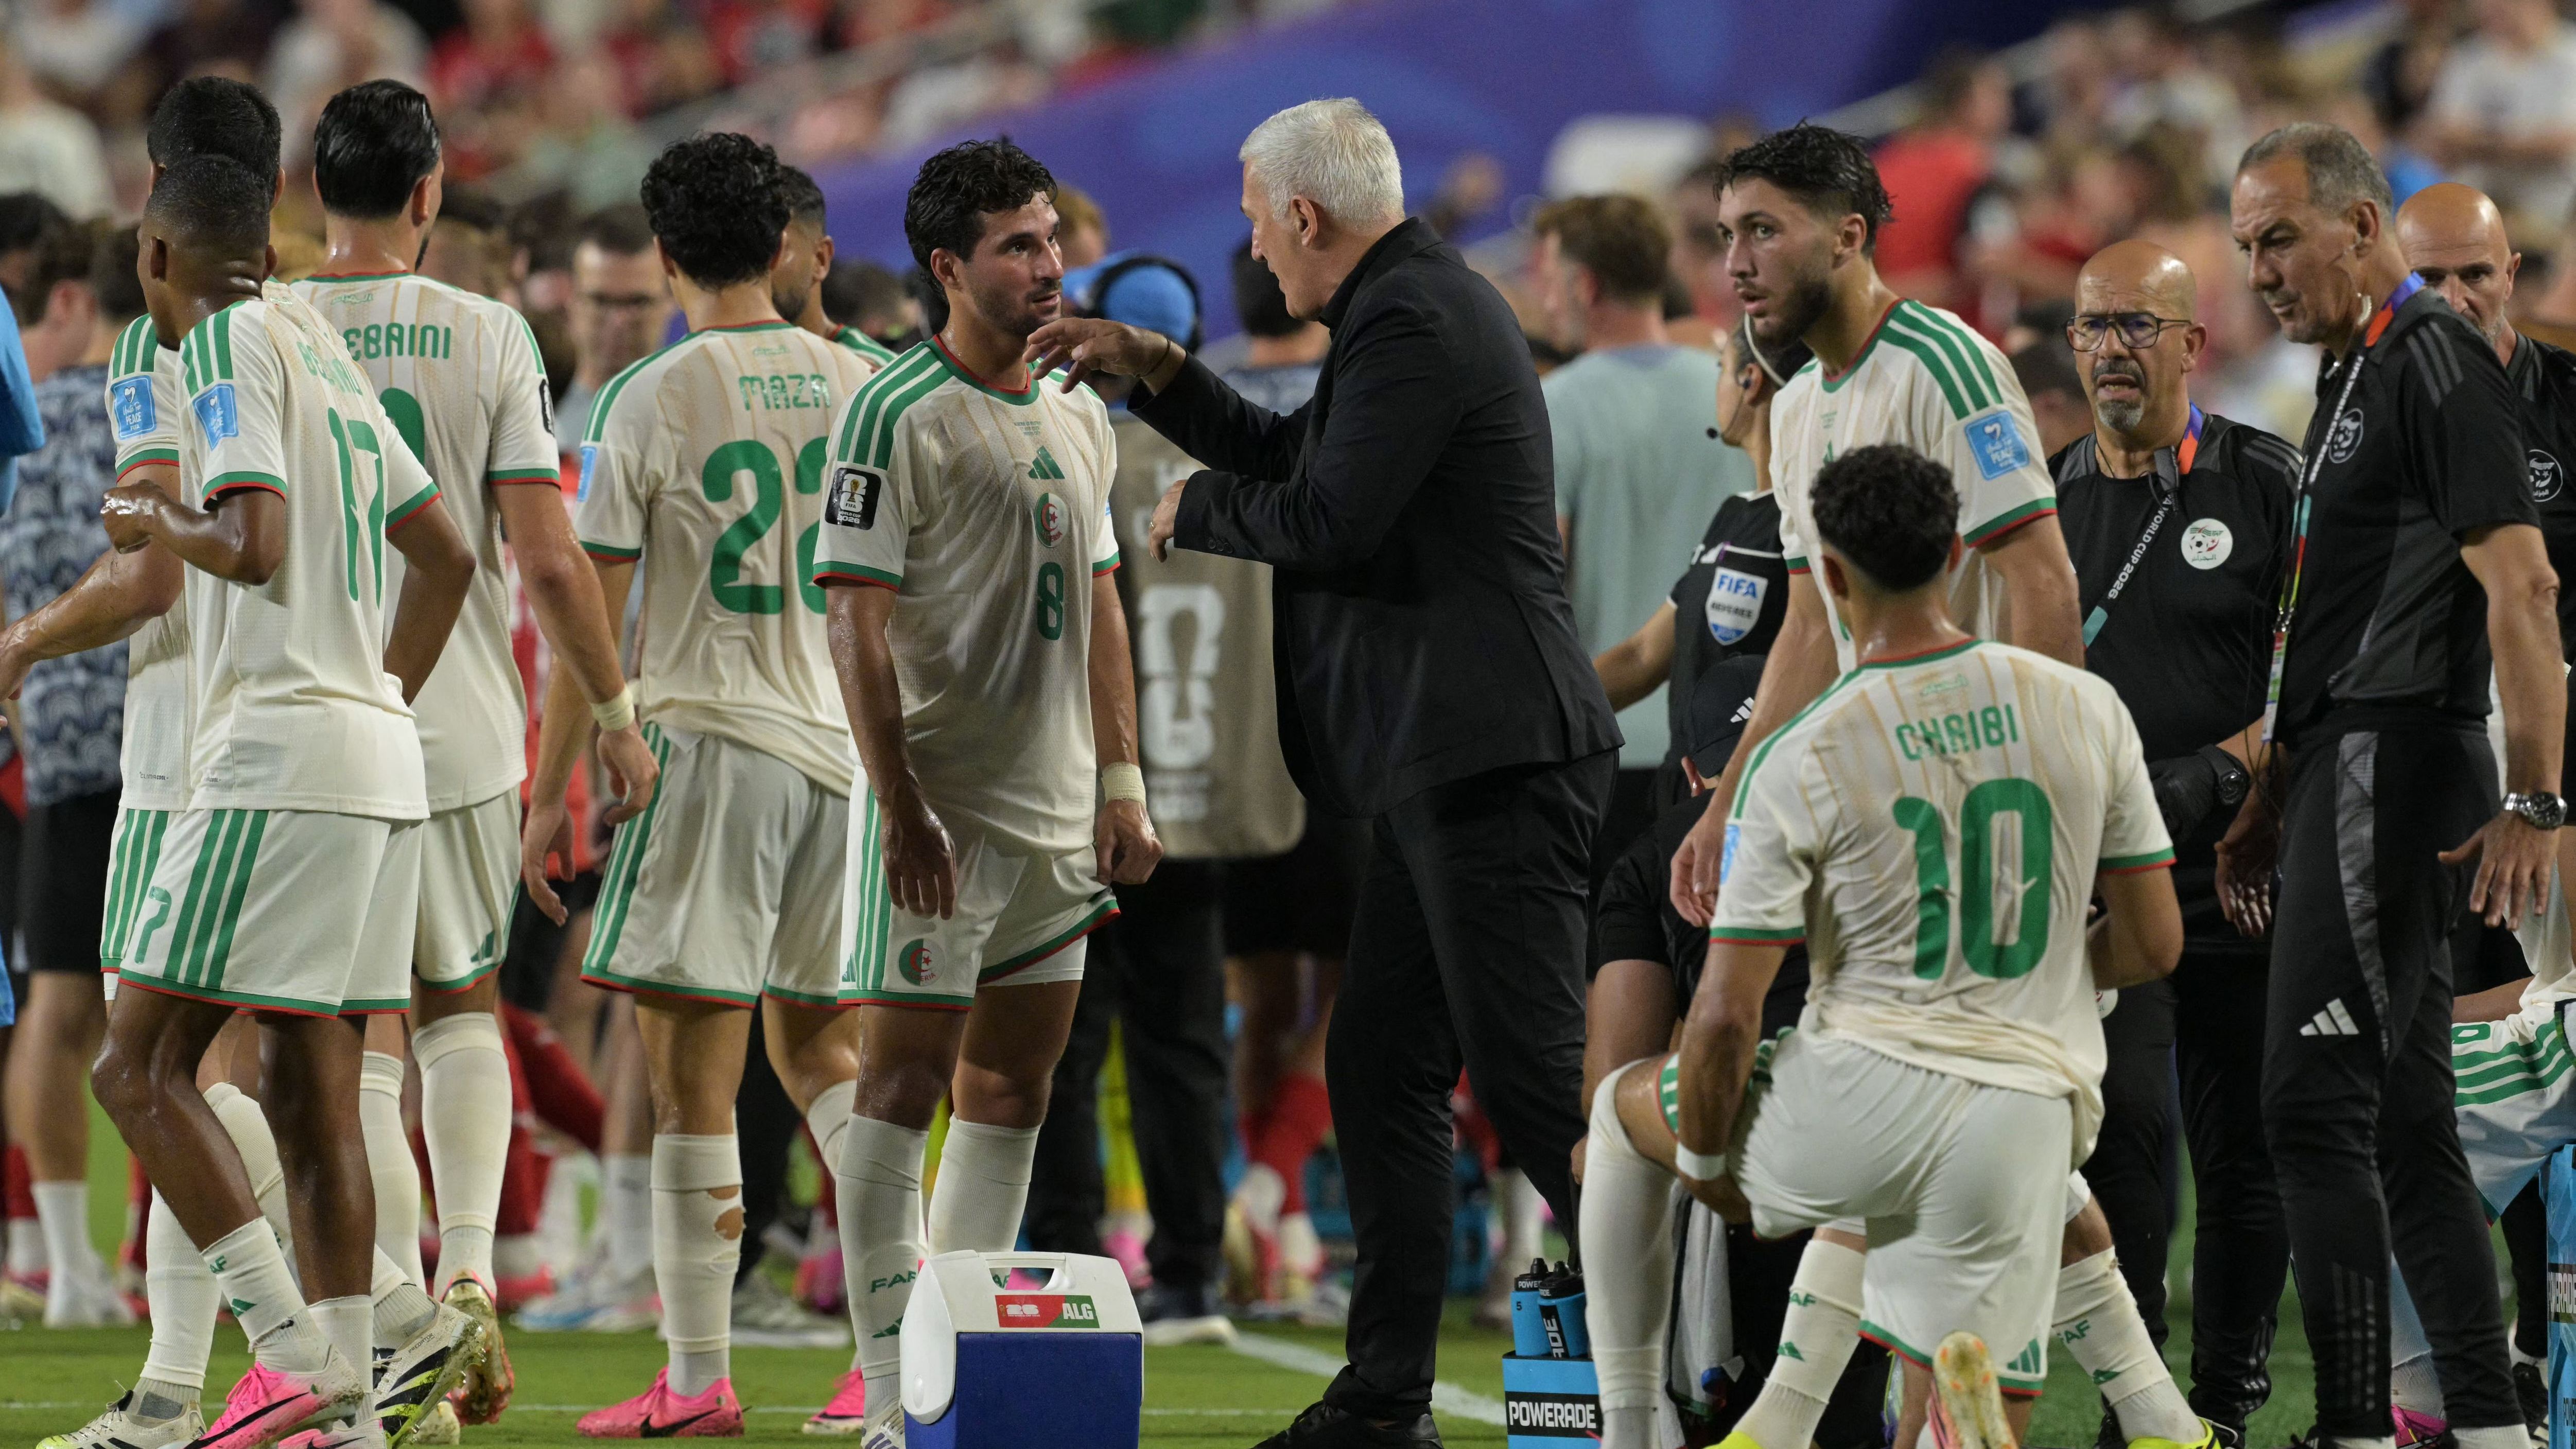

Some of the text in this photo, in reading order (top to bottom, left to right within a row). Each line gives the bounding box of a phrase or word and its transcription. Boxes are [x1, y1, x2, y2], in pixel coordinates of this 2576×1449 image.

[343, 322, 451, 361] EBAINI
[739, 374, 831, 411] MAZA
[126, 412, 142, 426] PEACE
[328, 407, 385, 609] 17
[837, 515, 860, 524] 2026
[2131, 543, 2146, 565] CUP
[1718, 574, 1758, 599] FIFA
[2108, 563, 2134, 600] 2026
[1037, 562, 1064, 641] 8
[1892, 777, 2053, 980] 10
[210, 1254, 228, 1275] AF
[871, 1271, 916, 1293] FAF
[1062, 1303, 1094, 1320] ALG
[1516, 1301, 1523, 1311] 5
[1790, 1293, 1817, 1307] AF
[408, 1332, 434, 1354] PREDATOR
[1543, 1318, 1565, 1358] ADE
[2064, 1319, 2091, 1344] AF
[1508, 1401, 1596, 1429] POWERADE
